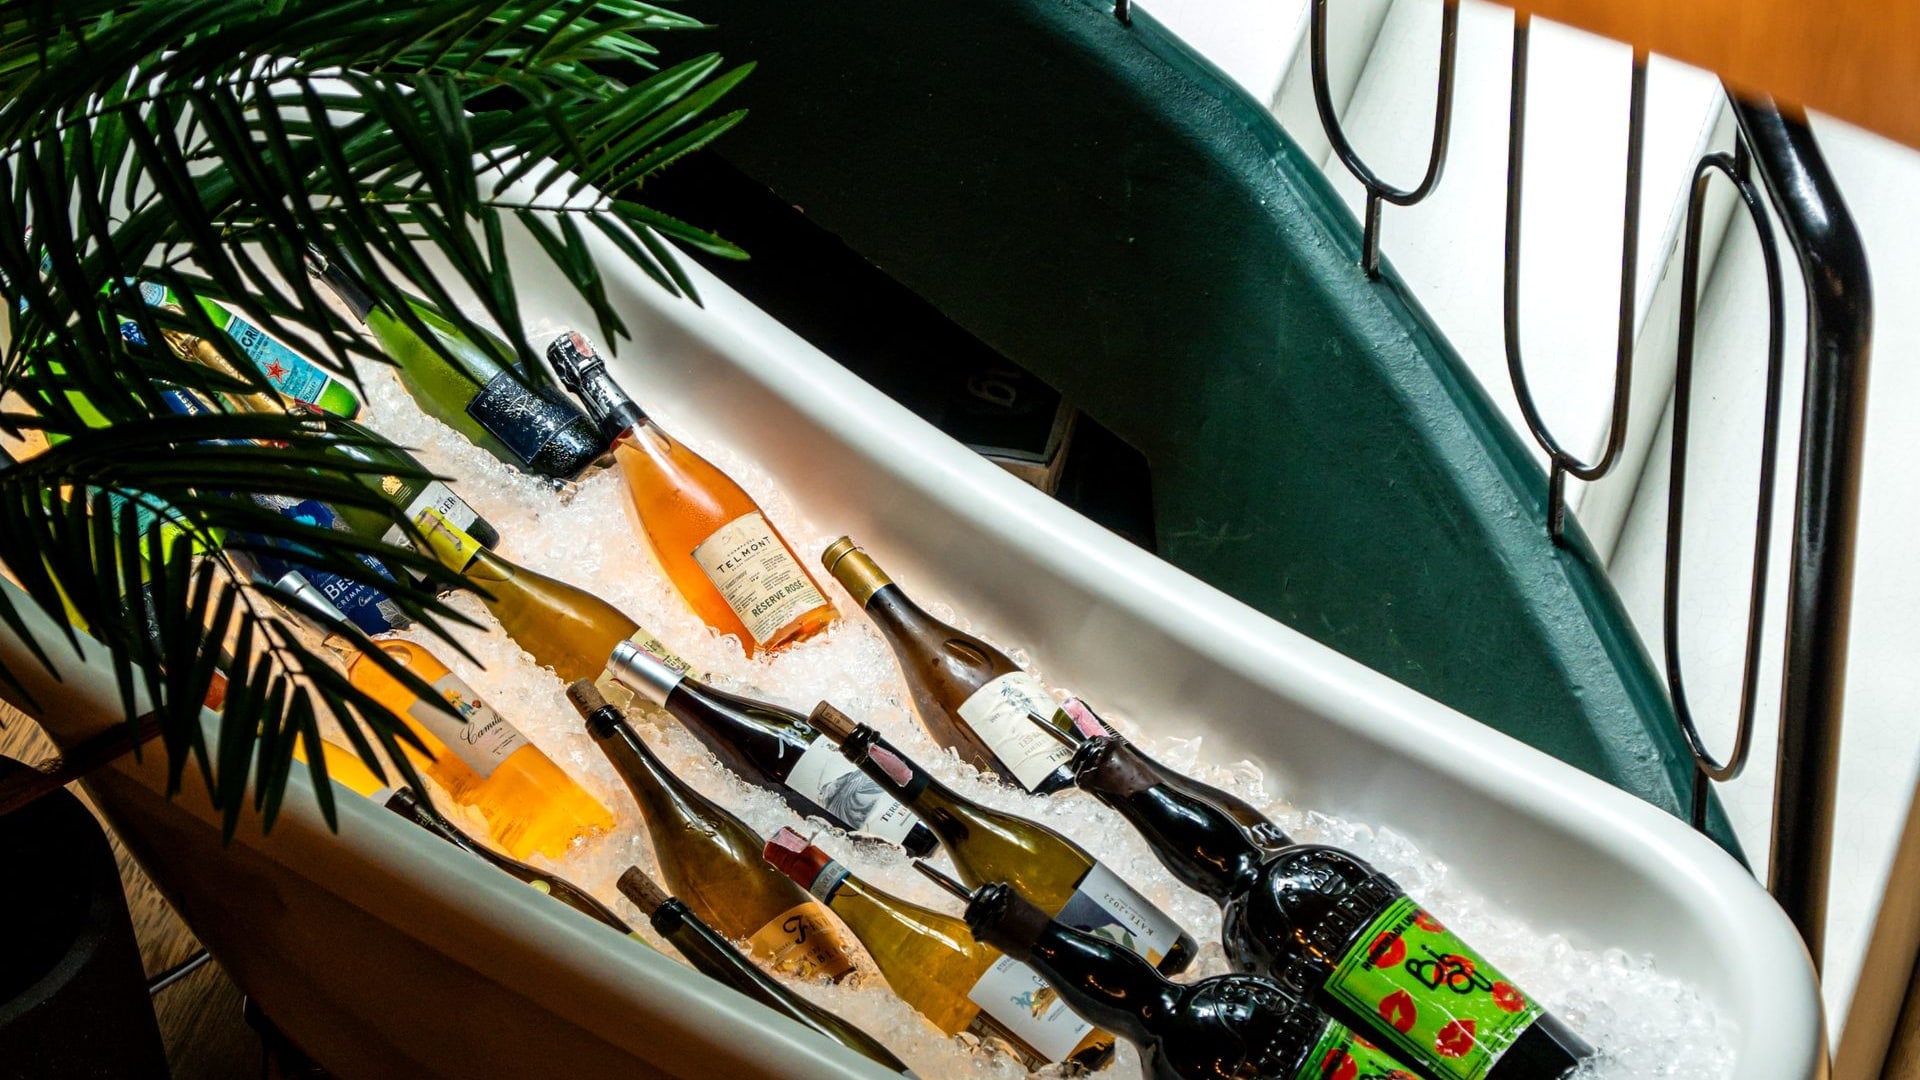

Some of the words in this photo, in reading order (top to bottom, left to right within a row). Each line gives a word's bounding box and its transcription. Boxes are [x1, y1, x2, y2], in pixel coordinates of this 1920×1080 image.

[716, 535, 771, 573] TELMONT
[335, 583, 365, 609] CRÉMAN
[750, 587, 786, 617] RÉSERVE
[784, 578, 804, 594] ROSÉ
[1103, 892, 1125, 911] 2022
[1129, 911, 1154, 936] KATE
[1361, 923, 1407, 971] HOMEMADE
